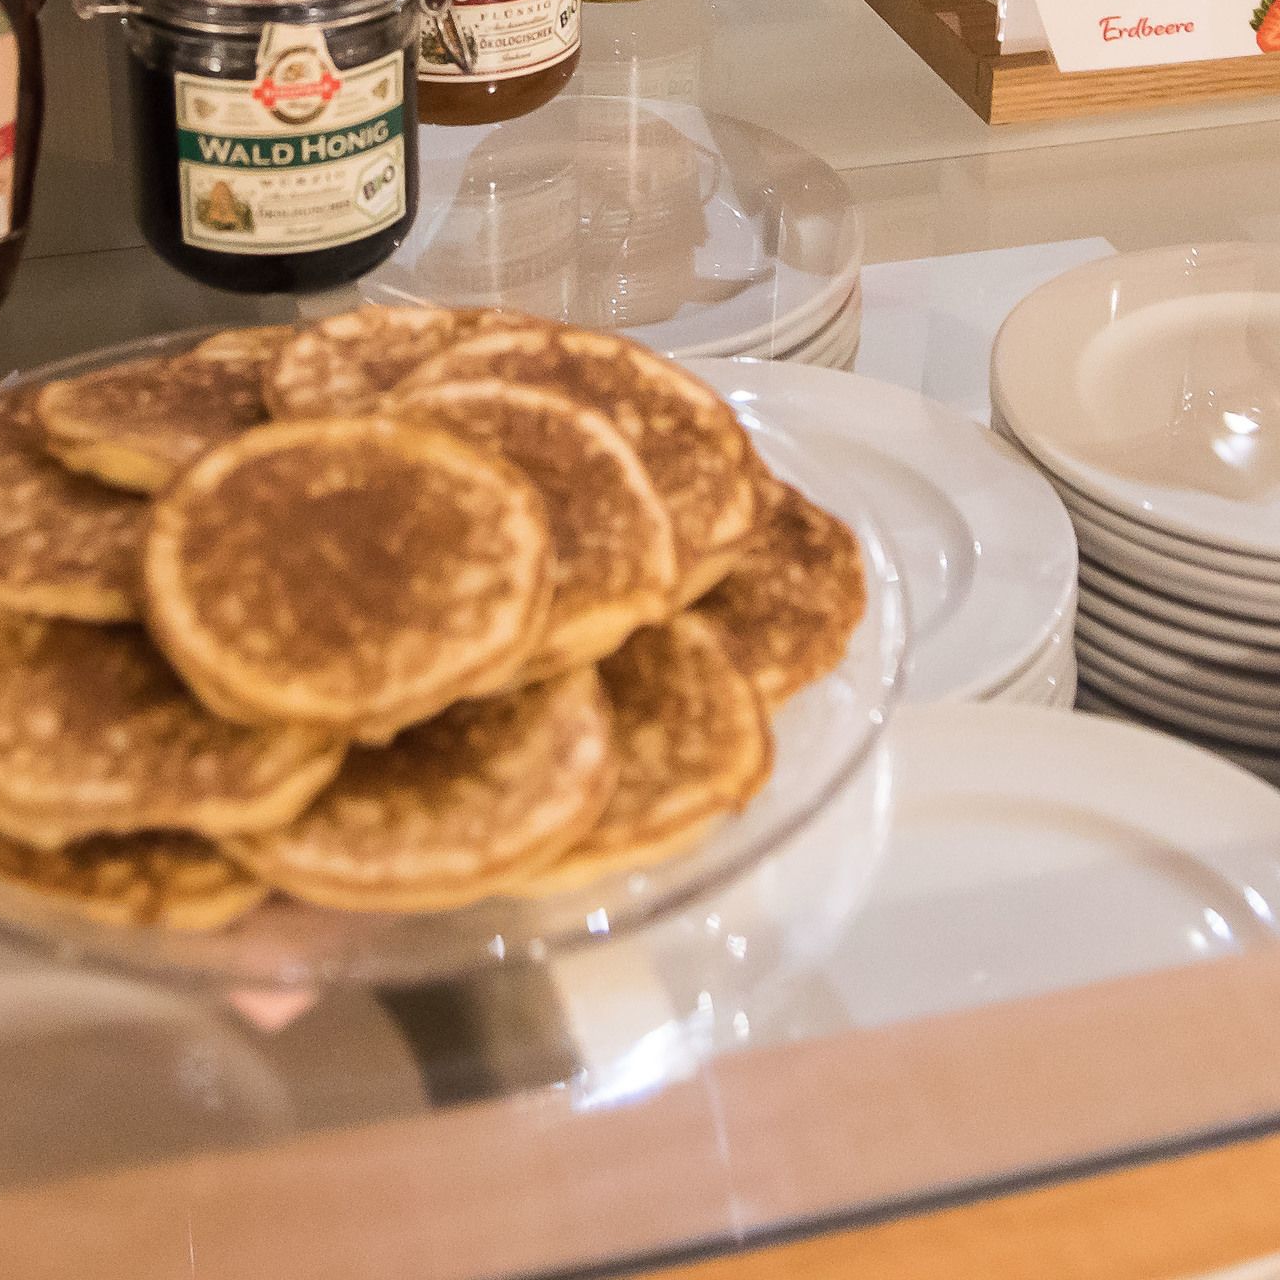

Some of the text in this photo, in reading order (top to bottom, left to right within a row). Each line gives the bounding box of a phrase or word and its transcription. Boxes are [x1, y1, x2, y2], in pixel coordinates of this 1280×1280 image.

[479, 26, 553, 49] ÖKOLOGISCHER
[1099, 15, 1195, 42] Erdbeere
[198, 119, 389, 166] WALD HONIG
